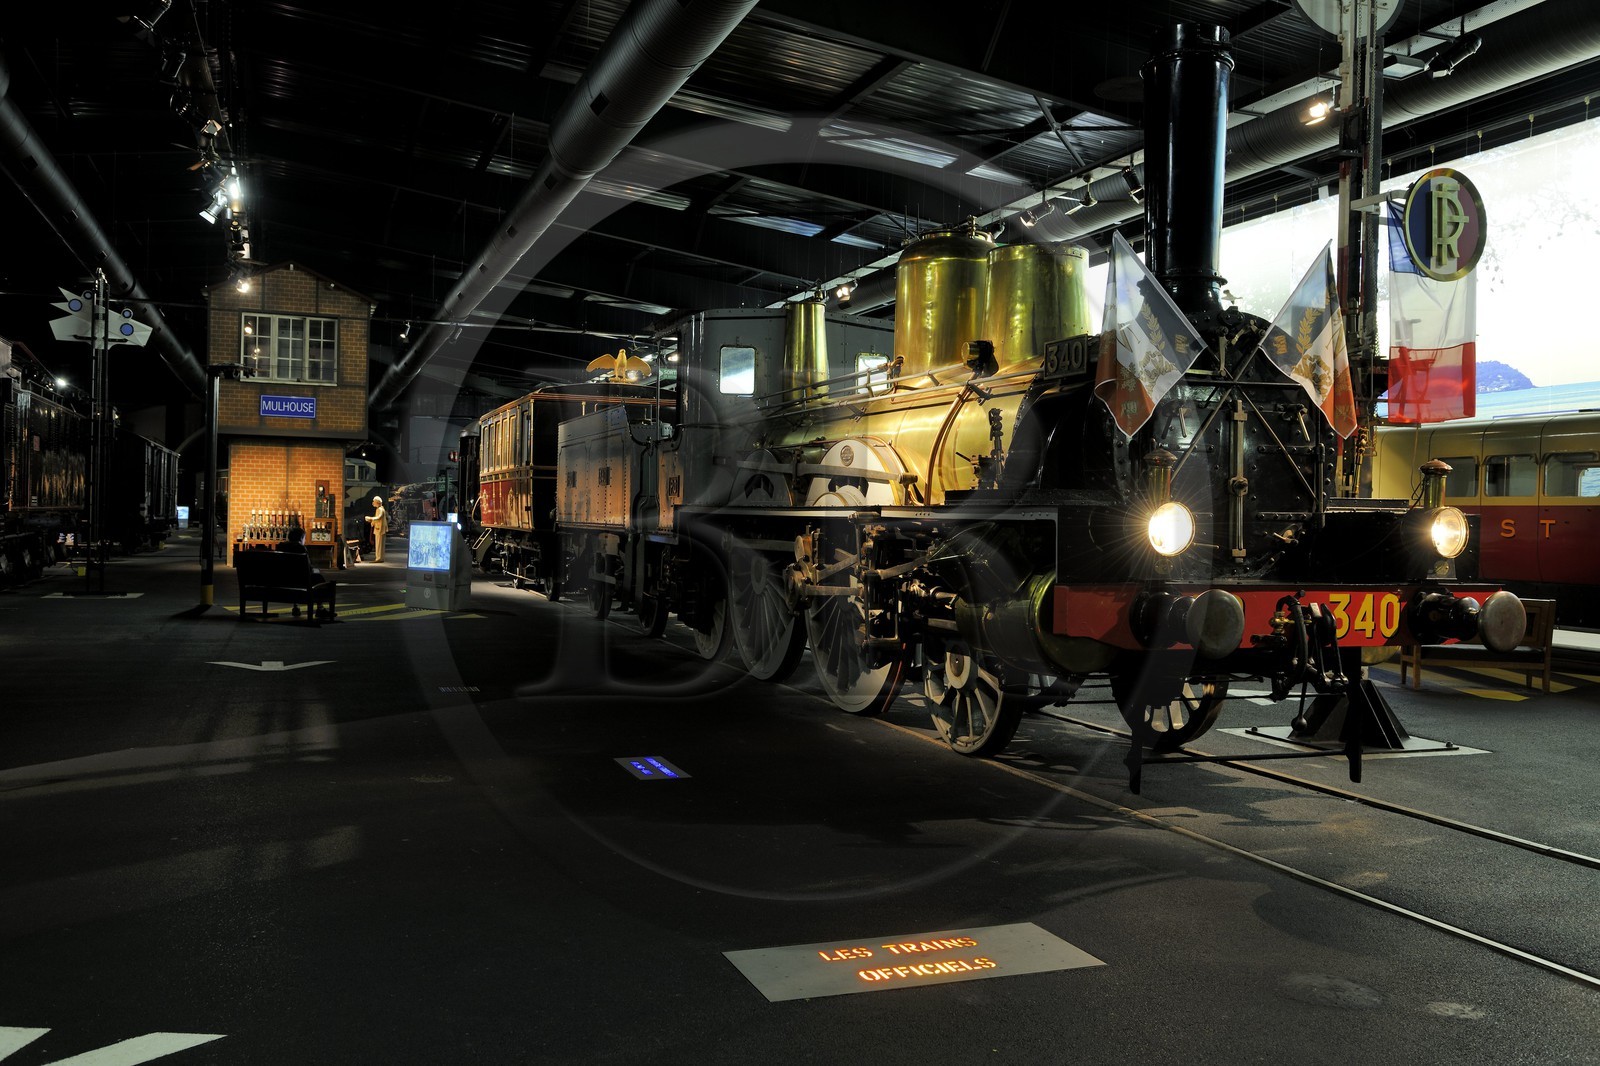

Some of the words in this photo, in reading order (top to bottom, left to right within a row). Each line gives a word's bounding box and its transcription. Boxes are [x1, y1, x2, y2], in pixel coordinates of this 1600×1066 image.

[1047, 341, 1083, 374] 340
[262, 400, 314, 413] MULHOUSE
[1328, 593, 1400, 639] 340
[817, 946, 874, 962] LES
[881, 936, 979, 956] TRAINS
[857, 957, 998, 982] OFFICIELS
